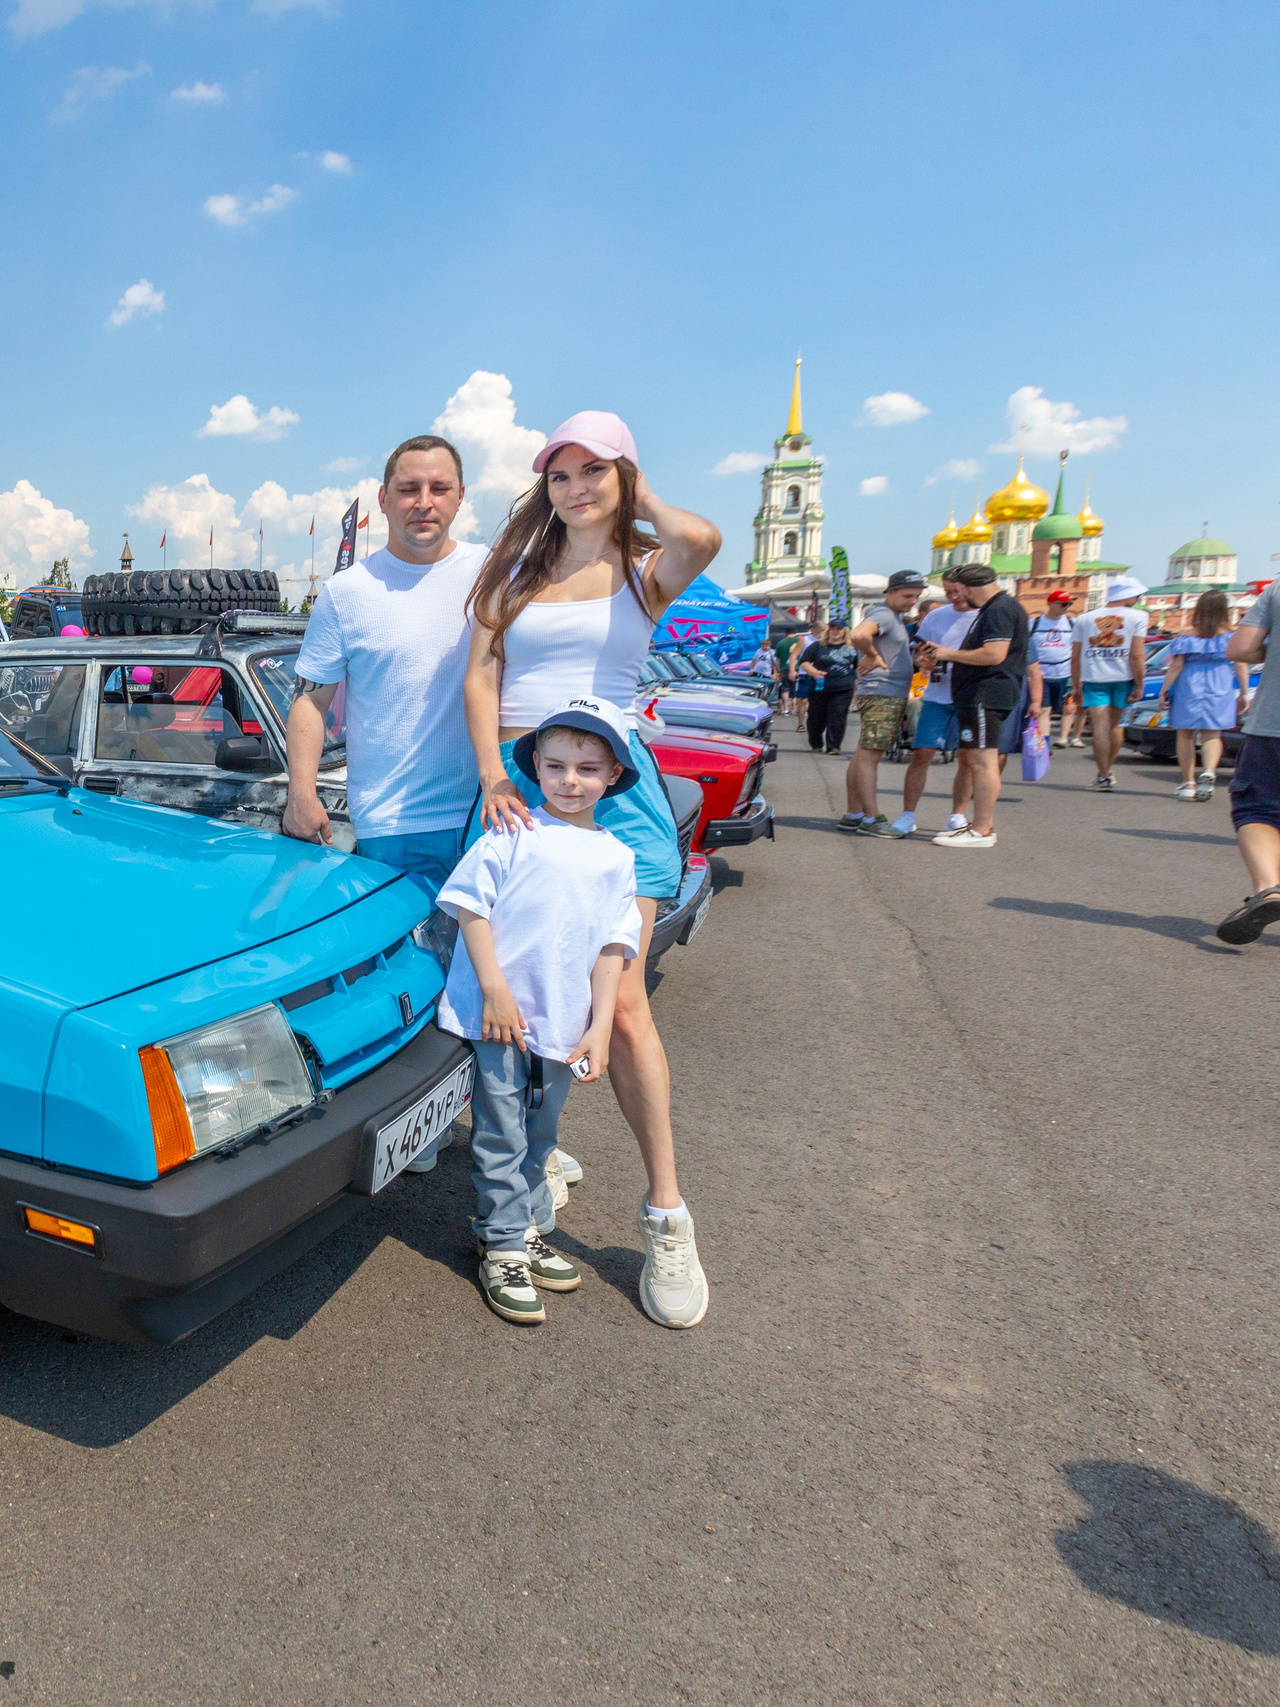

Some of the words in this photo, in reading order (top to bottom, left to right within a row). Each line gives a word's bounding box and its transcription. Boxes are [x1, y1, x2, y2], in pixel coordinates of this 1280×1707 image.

[1085, 648, 1129, 659] CRIME
[569, 699, 600, 711] FILA
[383, 1089, 455, 1180] Х469УР
